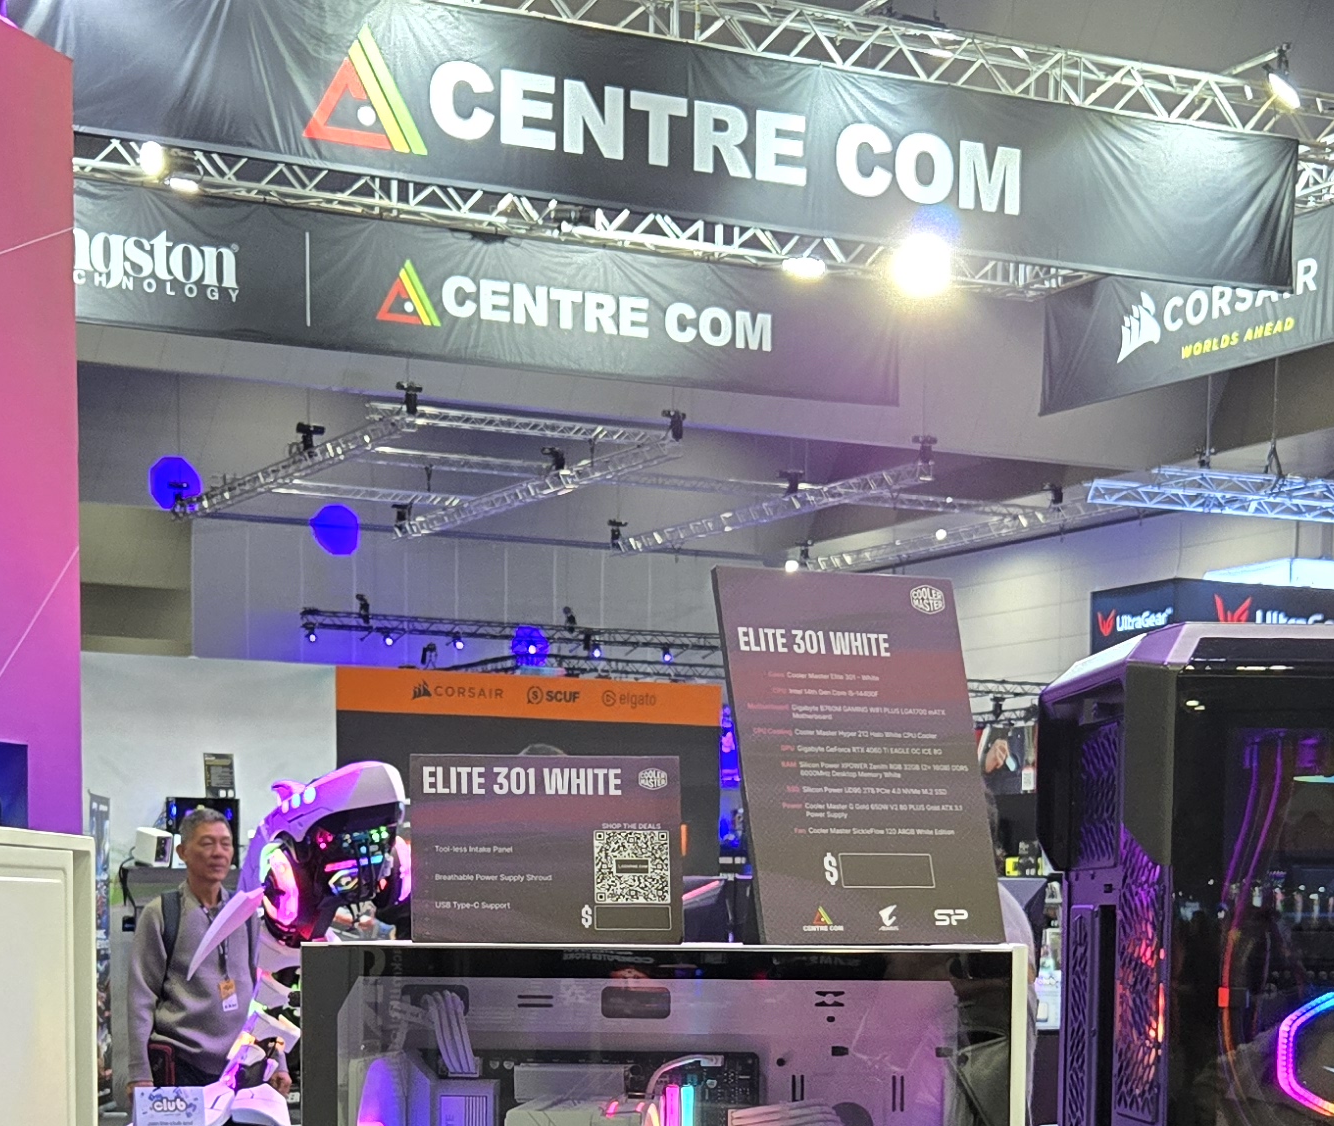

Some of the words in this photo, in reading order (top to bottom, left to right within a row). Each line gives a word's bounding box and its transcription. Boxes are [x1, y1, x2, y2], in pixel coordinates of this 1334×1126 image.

[429, 60, 807, 187] CENTRE
[835, 123, 1022, 215] COM
[1163, 257, 1319, 332] CORSR
[441, 276, 650, 338] CENTRE
[665, 301, 772, 352] COM
[1181, 332, 1239, 360] WORLDS
[1244, 316, 1296, 344] AHEAD
[911, 586, 943, 600] COOLER
[912, 599, 944, 611] MASTER
[1116, 606, 1169, 632] UltraGear
[737, 627, 788, 653] ELITE
[791, 630, 825, 655] 301
[829, 631, 891, 658] WHITE
[434, 685, 504, 701] CORSAIR
[545, 690, 580, 704] SCUF
[619, 690, 657, 709] elgato
[422, 766, 485, 795] ELITE
[492, 766, 537, 796] 301
[543, 768, 622, 796] WHITE
[638, 768, 668, 780] COOLER
[638, 777, 667, 788] MASTER
[434, 845, 467, 854] Tool-less
[468, 845, 492, 854] Intake
[493, 846, 513, 854] Panel
[434, 873, 475, 882] Breathable
[475, 874, 498, 882] Power
[499, 874, 525, 884] Supply
[526, 874, 553, 882] Shroud
[435, 901, 451, 910] USB
[452, 901, 480, 911] Type-C
[481, 901, 511, 911] Support
[934, 909, 969, 926] SP
[153, 1098, 187, 1111] club
